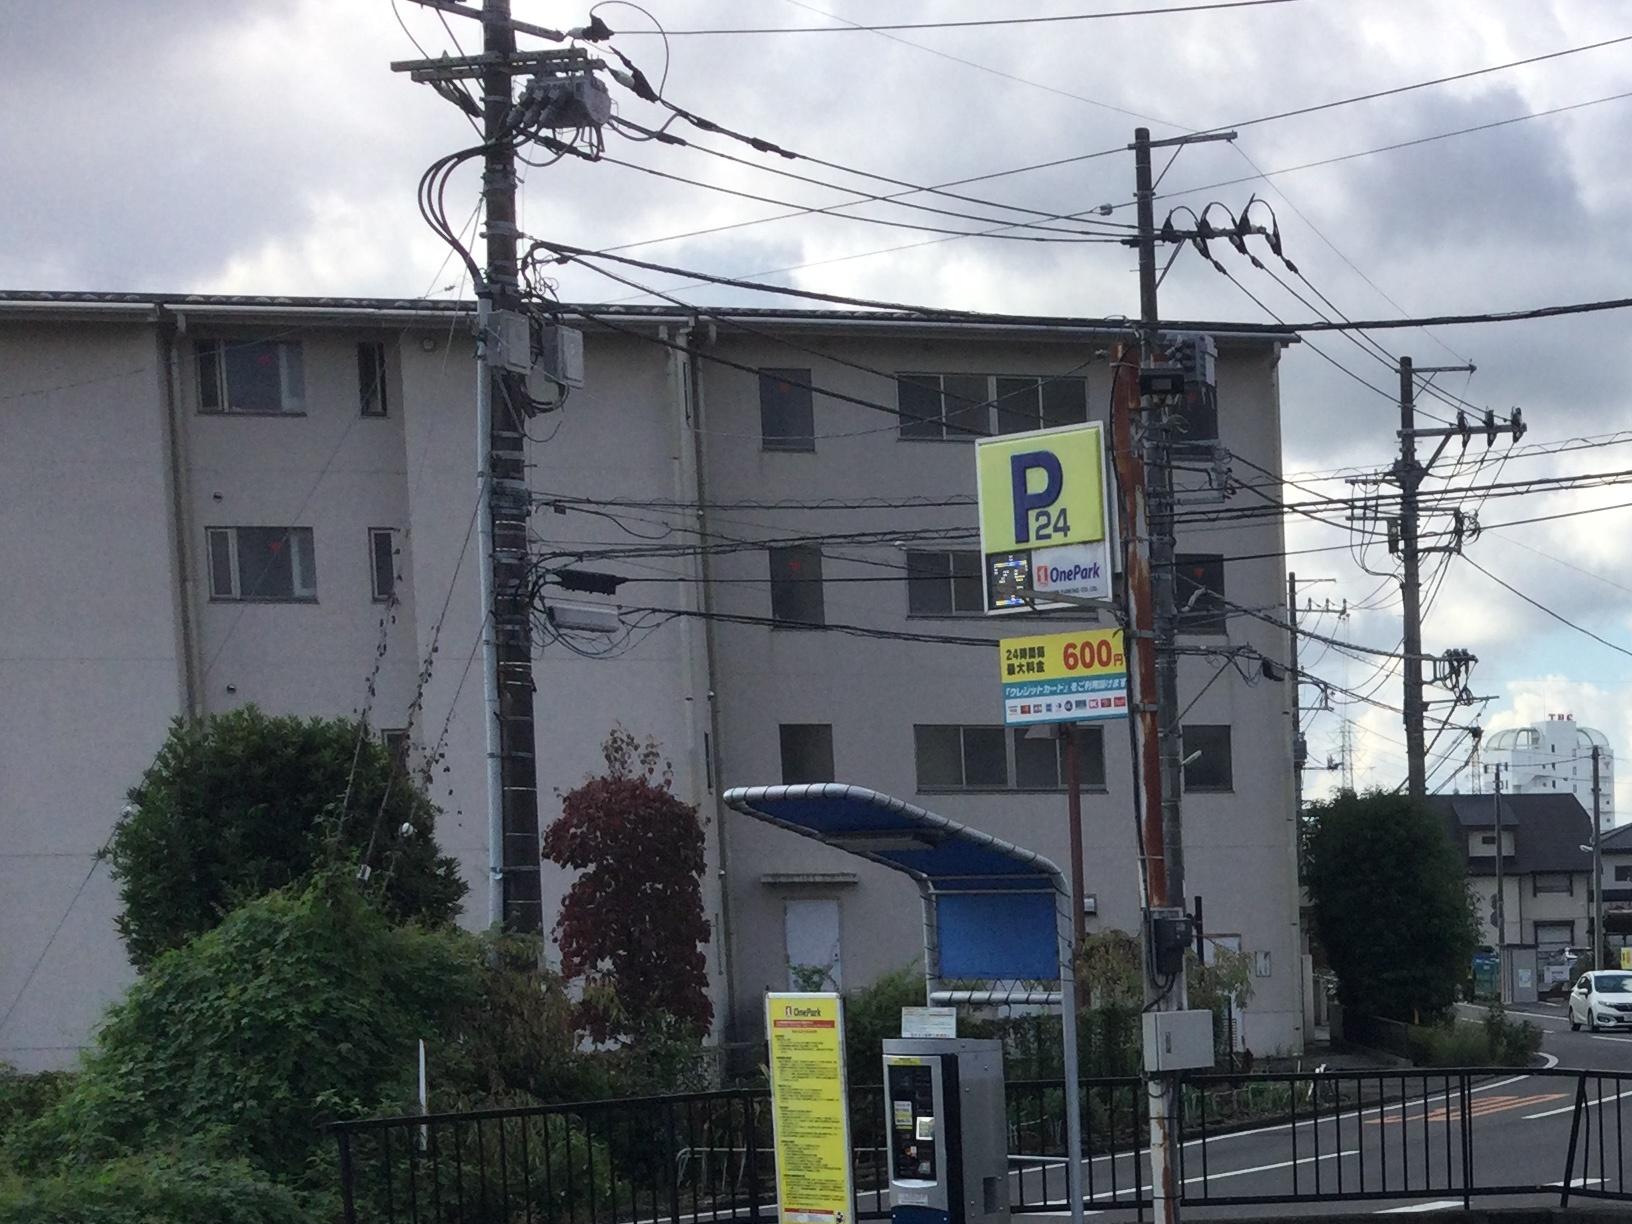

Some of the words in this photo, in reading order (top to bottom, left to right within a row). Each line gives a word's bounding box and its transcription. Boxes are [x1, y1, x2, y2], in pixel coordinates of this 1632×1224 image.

[1010, 450, 1063, 544] P
[1035, 508, 1071, 541] 24
[1050, 562, 1100, 583] OnePark
